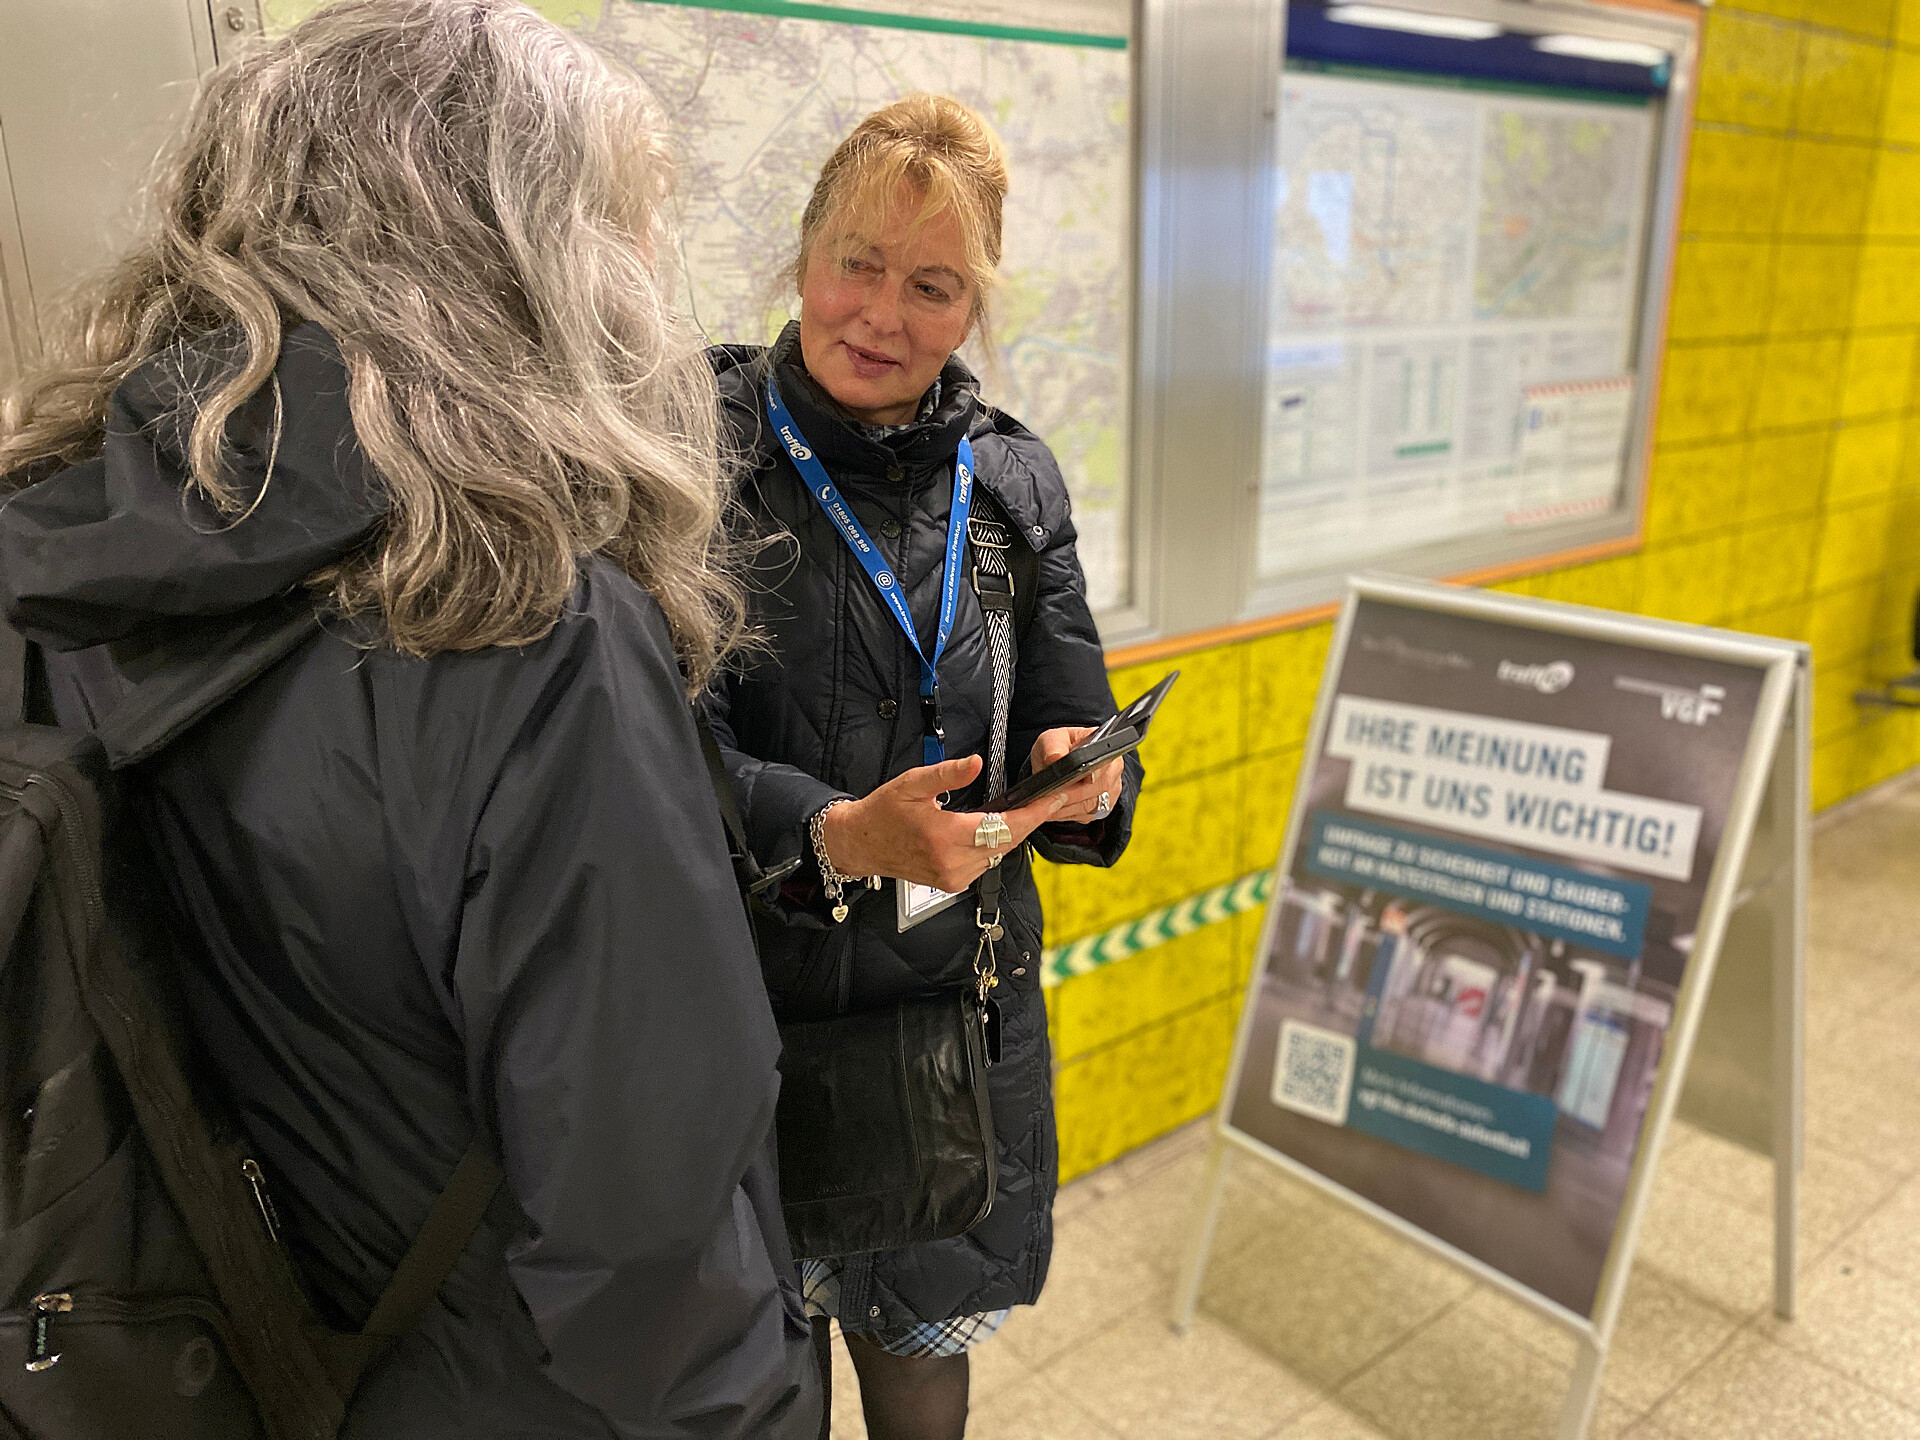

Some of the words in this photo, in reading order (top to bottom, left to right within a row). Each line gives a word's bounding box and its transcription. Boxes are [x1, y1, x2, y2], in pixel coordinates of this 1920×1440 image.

[833, 502, 851, 524] 01805
[952, 521, 961, 551] Frankfurt
[1344, 711, 1420, 755] IHRE
[1426, 724, 1588, 785] MEINUNG
[1362, 763, 1416, 801] IST
[1422, 774, 1493, 819] UNS
[1504, 791, 1677, 859] WICHTIG!
[1510, 867, 1550, 897] UND
[1485, 886, 1525, 917] UND
